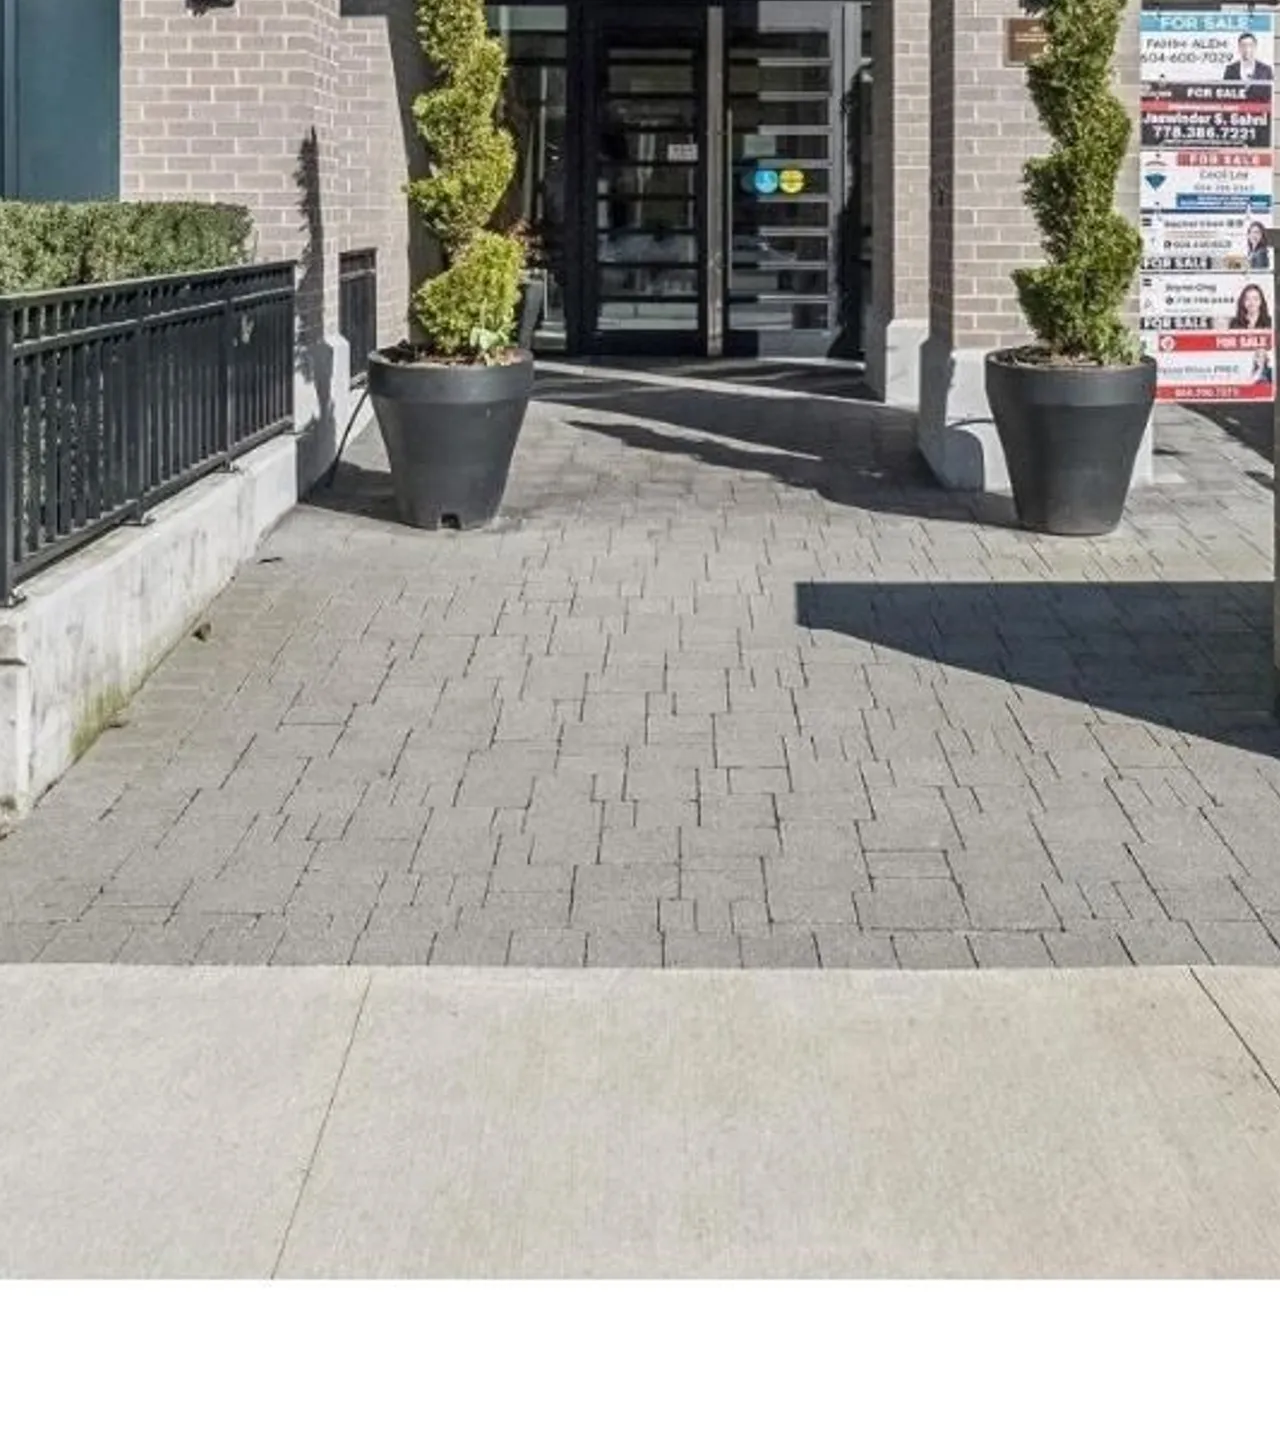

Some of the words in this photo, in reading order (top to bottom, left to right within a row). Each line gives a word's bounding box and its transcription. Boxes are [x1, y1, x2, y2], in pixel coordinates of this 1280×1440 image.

[1160, 16, 1198, 30] FOR
[1203, 16, 1249, 30] SALE
[1187, 87, 1213, 98] FOR
[1216, 87, 1248, 99] SALE
[1189, 154, 1218, 165] FOR
[1223, 154, 1260, 166] SALE
[1144, 257, 1171, 269] FOR
[1174, 257, 1207, 269] SALE
[1144, 318, 1171, 329] FOR
[1174, 317, 1208, 329] SALE
[1216, 337, 1238, 348] FOR
[1240, 337, 1268, 348] SALE
